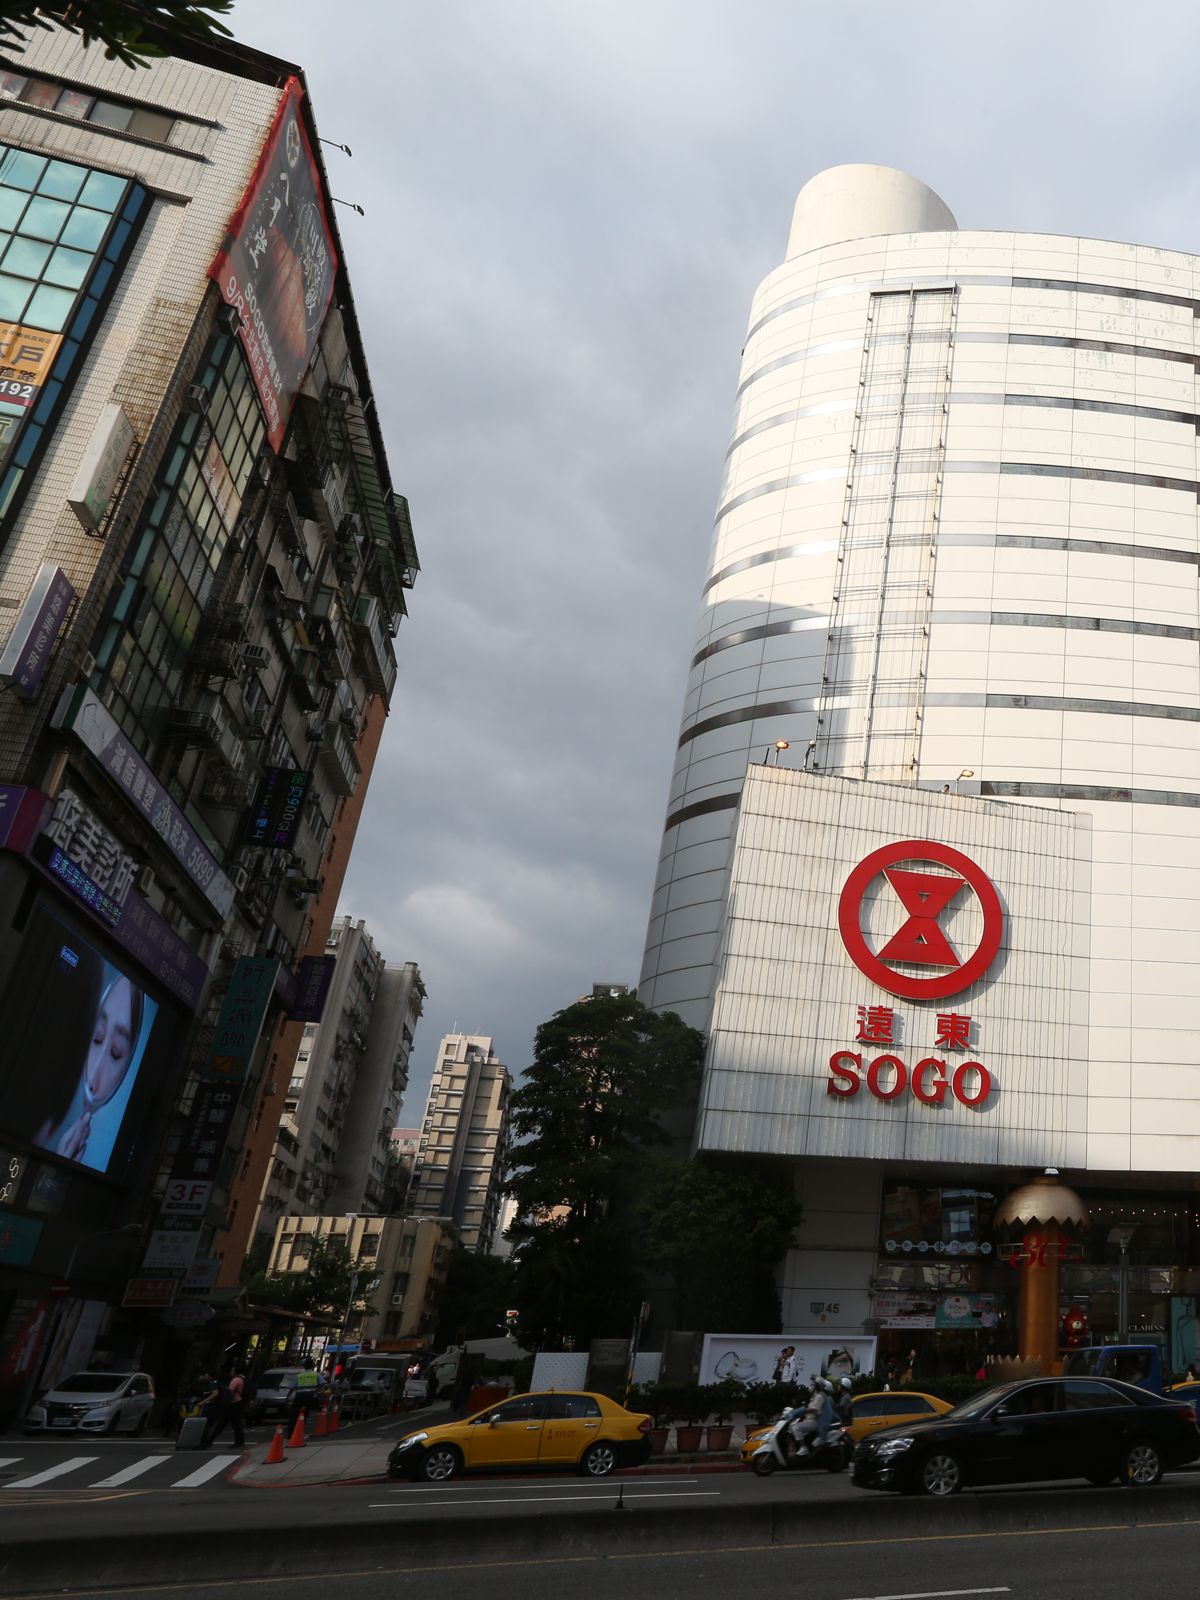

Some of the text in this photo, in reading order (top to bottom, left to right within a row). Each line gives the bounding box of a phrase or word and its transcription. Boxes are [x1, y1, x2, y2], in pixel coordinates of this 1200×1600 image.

[855, 1005, 972, 1050] 遠東
[826, 1050, 992, 1107] SOGO
[170, 1184, 208, 1202] 3F
[825, 1302, 840, 1315] 45
